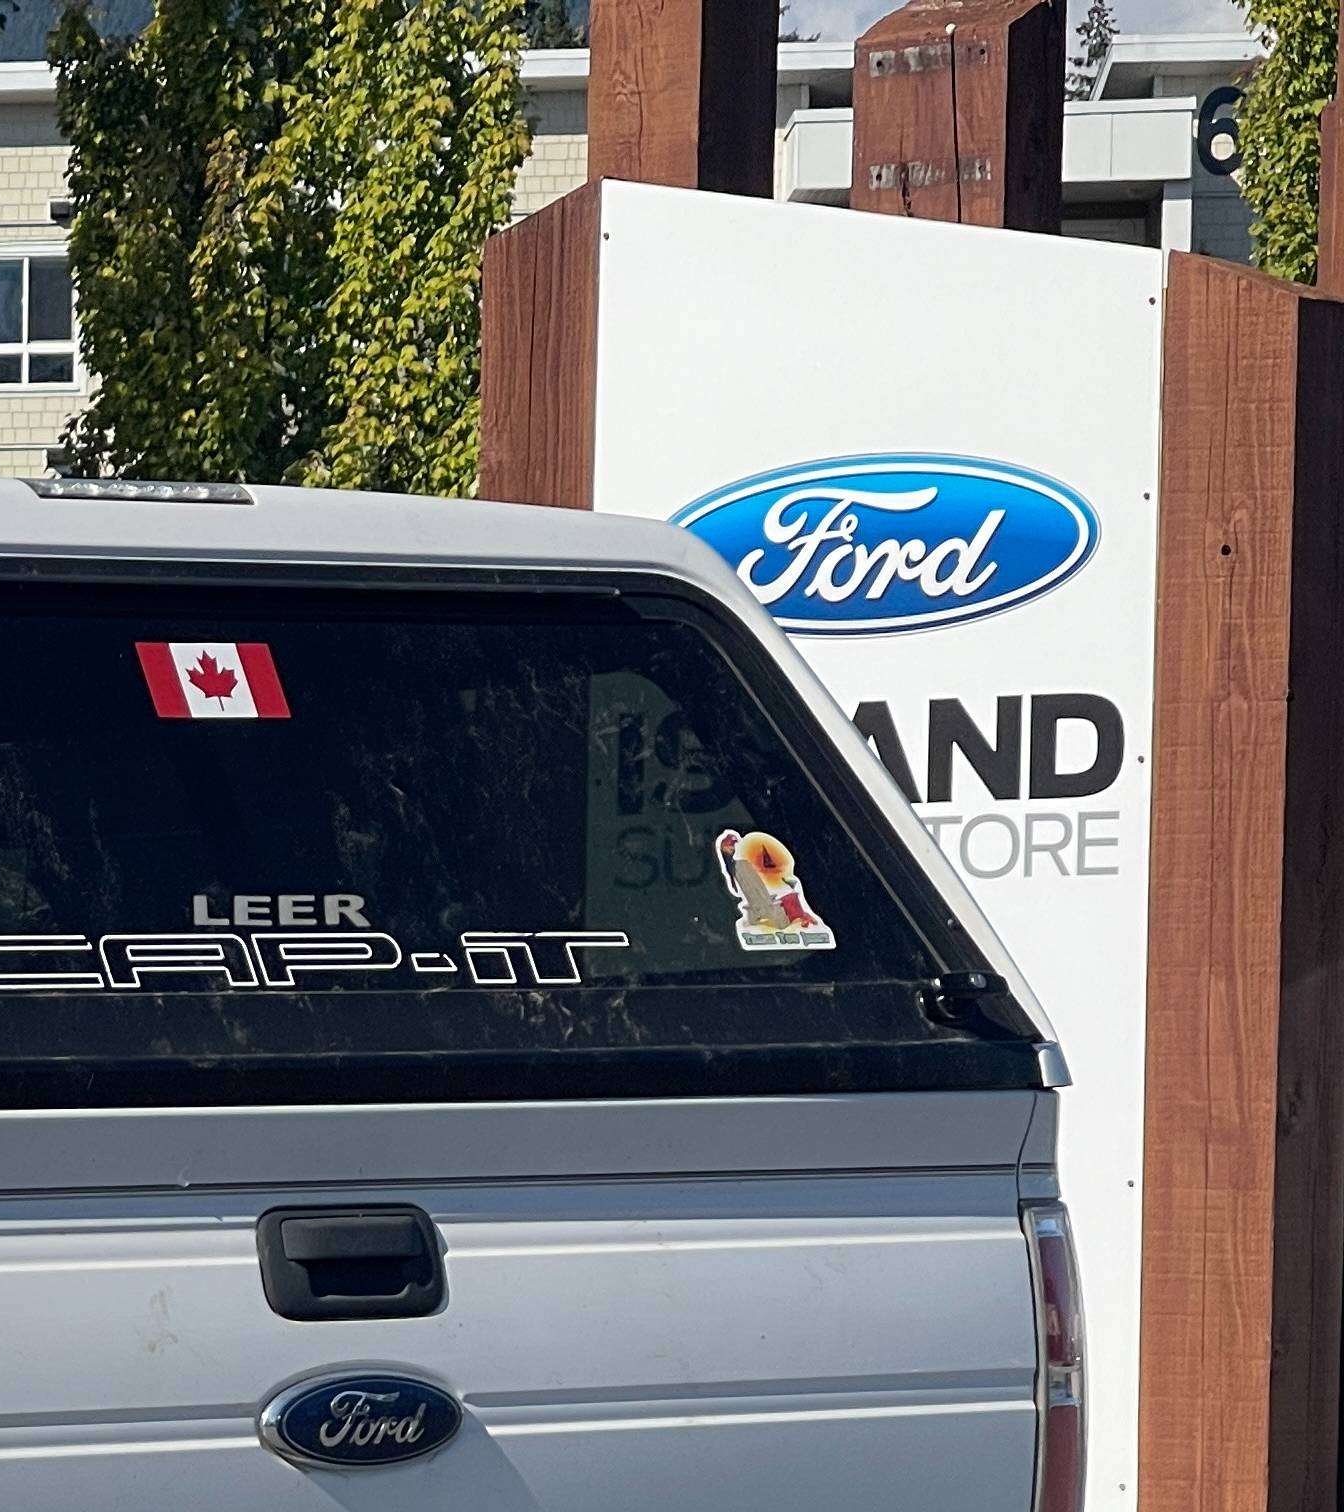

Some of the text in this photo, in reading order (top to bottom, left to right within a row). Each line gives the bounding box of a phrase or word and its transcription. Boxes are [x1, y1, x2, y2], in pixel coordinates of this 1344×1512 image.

[736, 487, 1006, 604] Ford
[192, 893, 374, 927] LEER
[319, 1390, 427, 1447] Ford
